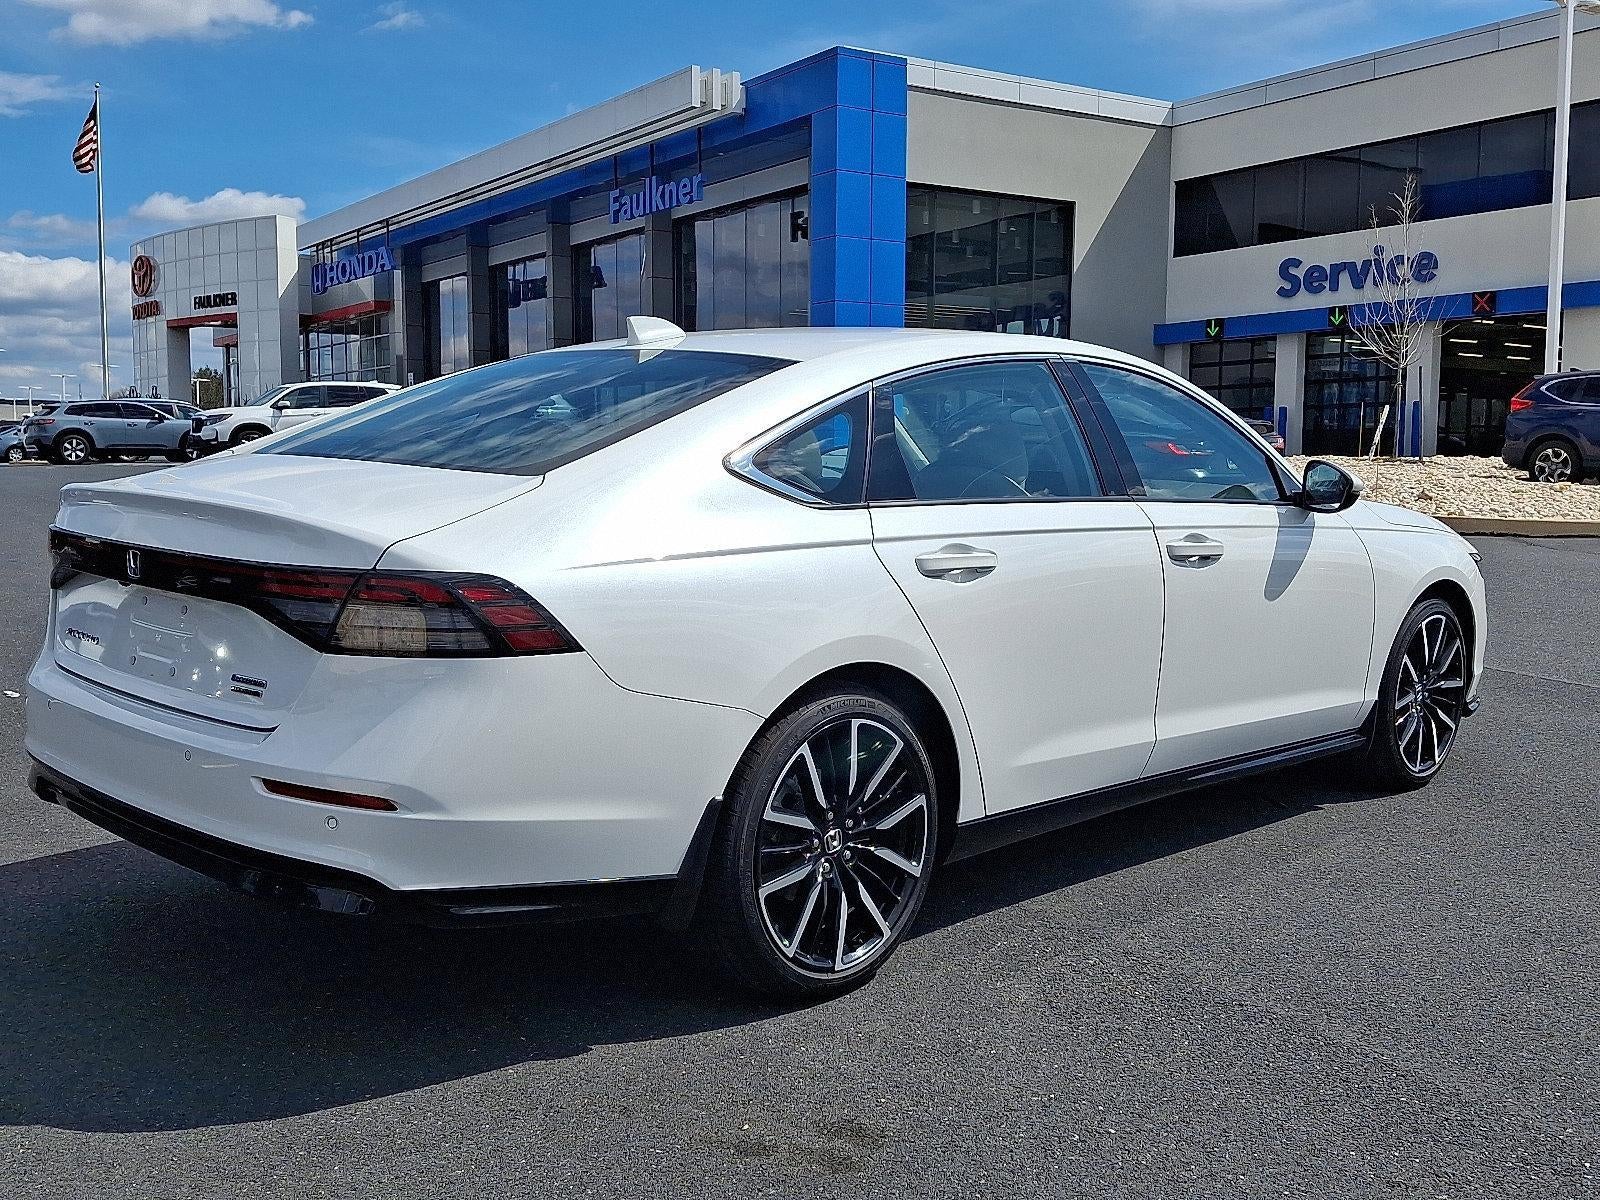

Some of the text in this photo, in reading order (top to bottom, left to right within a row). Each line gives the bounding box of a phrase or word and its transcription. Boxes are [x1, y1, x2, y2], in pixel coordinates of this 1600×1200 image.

[609, 173, 704, 224] Faulkner
[325, 246, 393, 288] HONDA
[1276, 244, 1439, 298] Service
[132, 300, 161, 320] TOYOTA
[193, 291, 238, 310] FAULKNER
